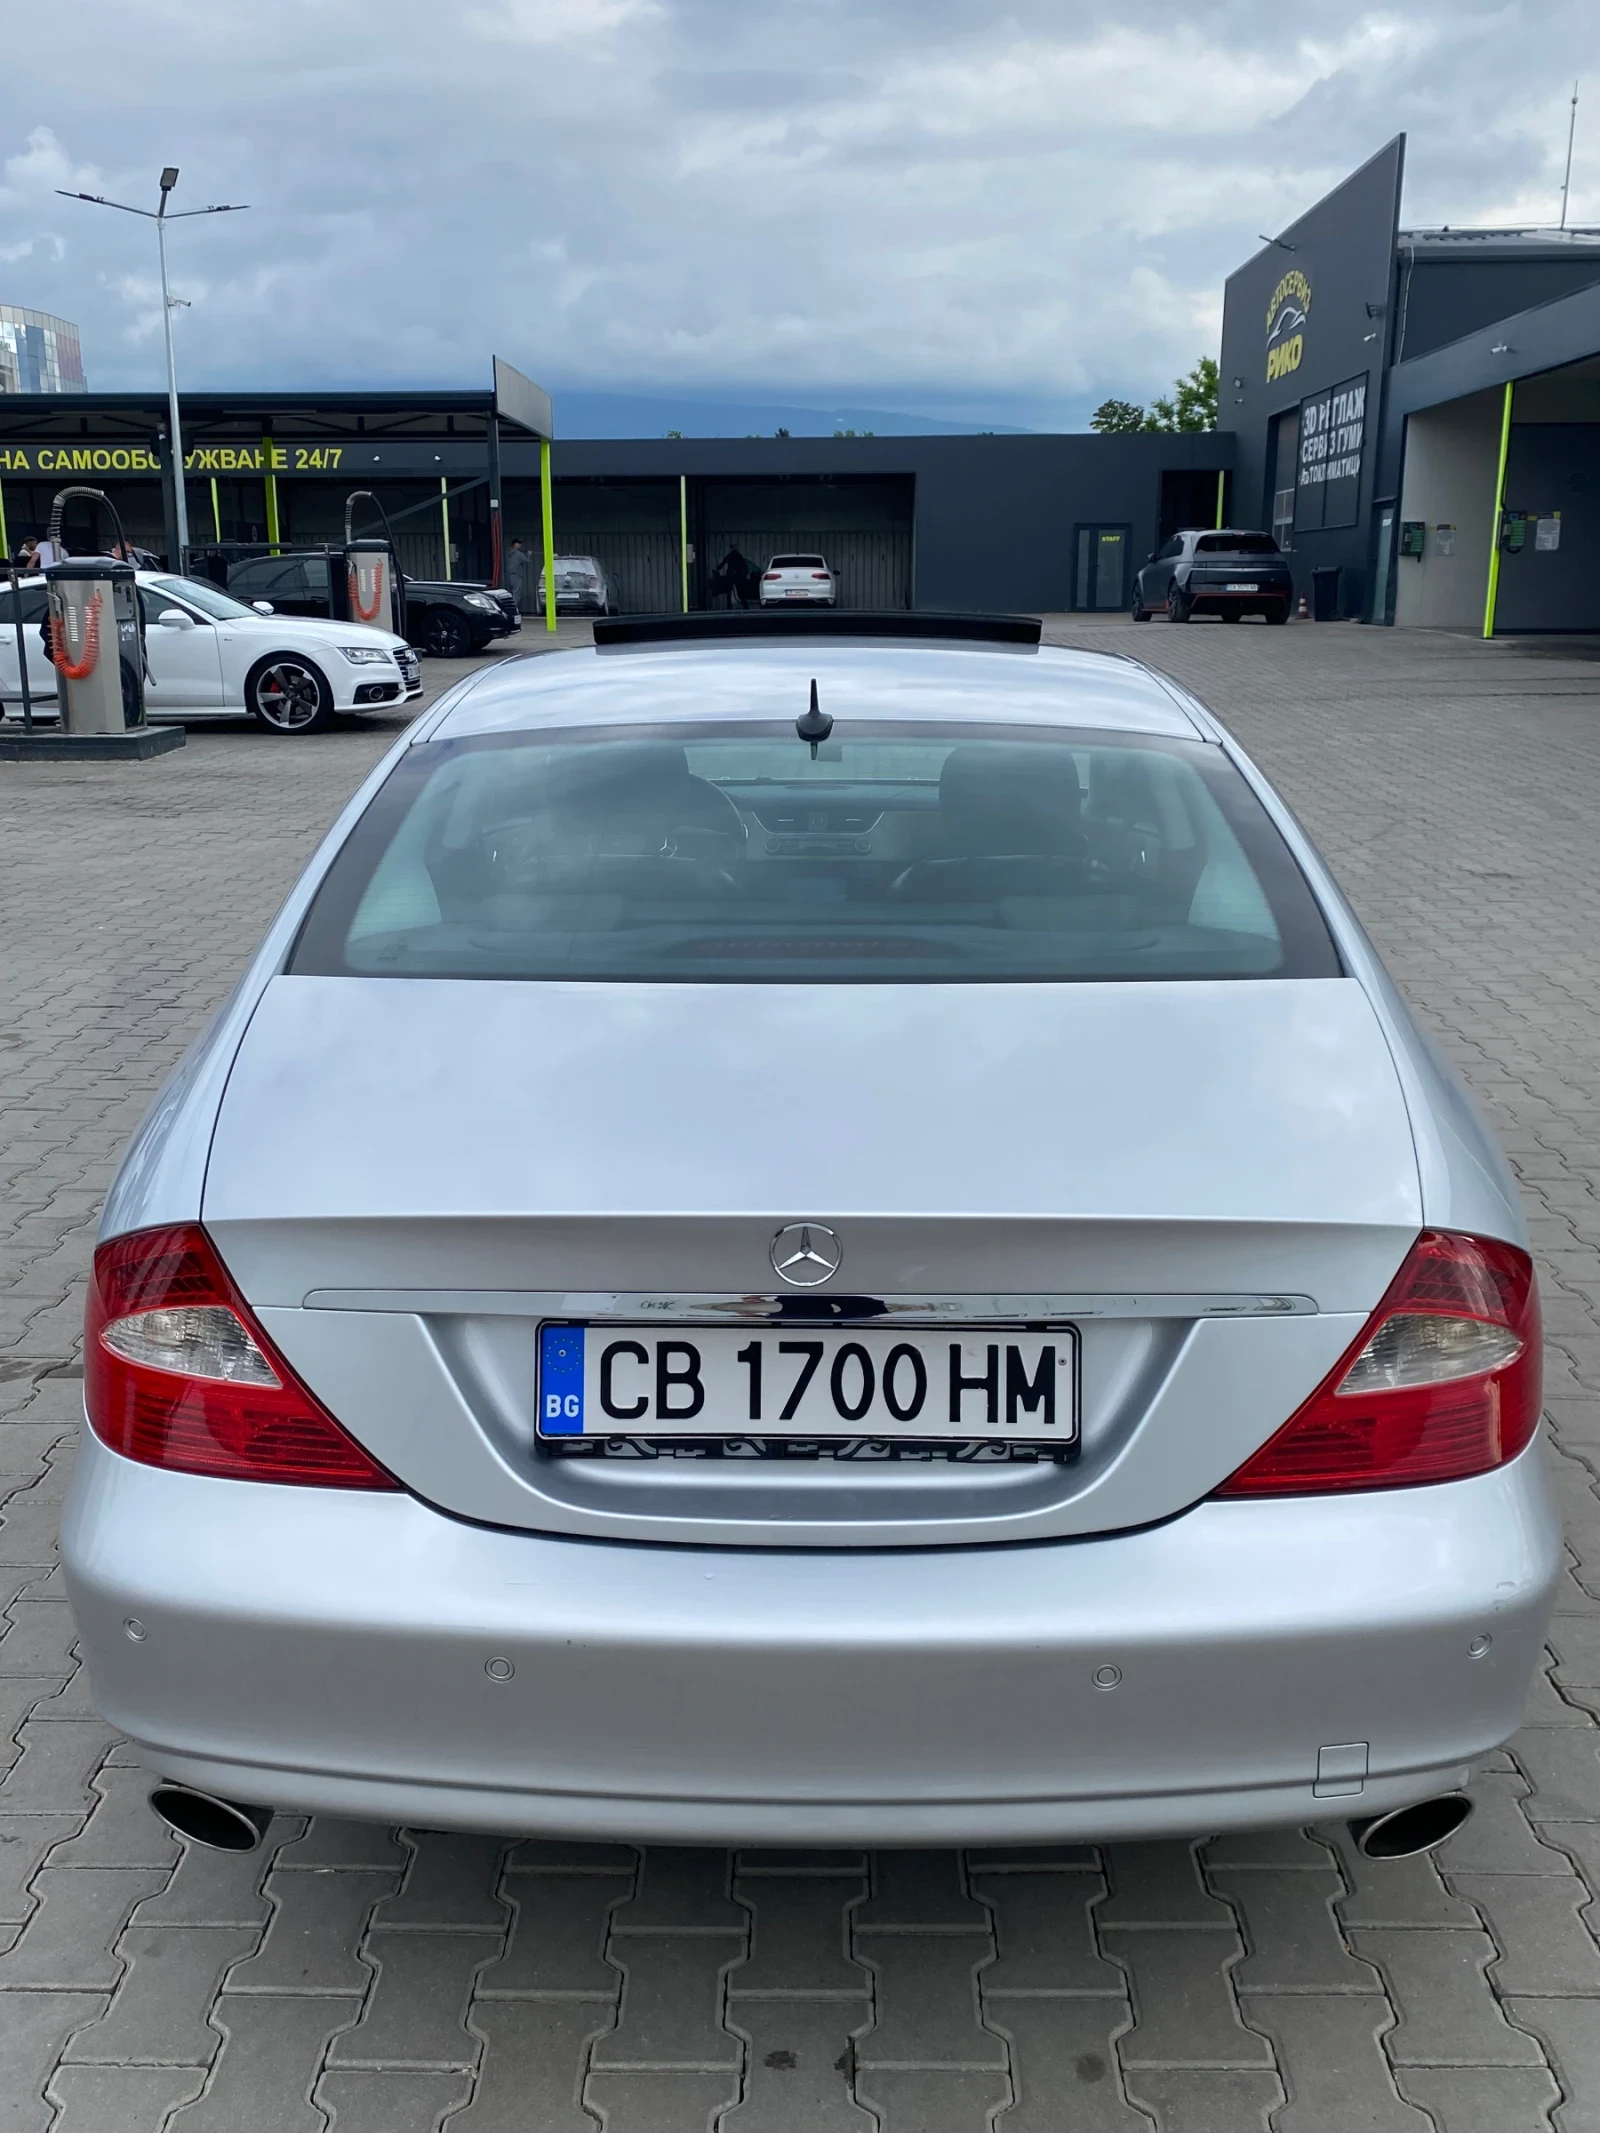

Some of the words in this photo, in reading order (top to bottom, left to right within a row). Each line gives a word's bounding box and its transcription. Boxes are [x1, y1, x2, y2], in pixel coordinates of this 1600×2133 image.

[1266, 333, 1303, 383] РИКО
[1304, 406, 1317, 437] 3D
[37, 449, 288, 470] САМООБСУЖВАНЕ
[295, 448, 342, 470] 24/7
[546, 1394, 580, 1419] BG
[600, 1340, 705, 1420] CB
[737, 1341, 927, 1421] 1700
[948, 1343, 1056, 1424] HM
